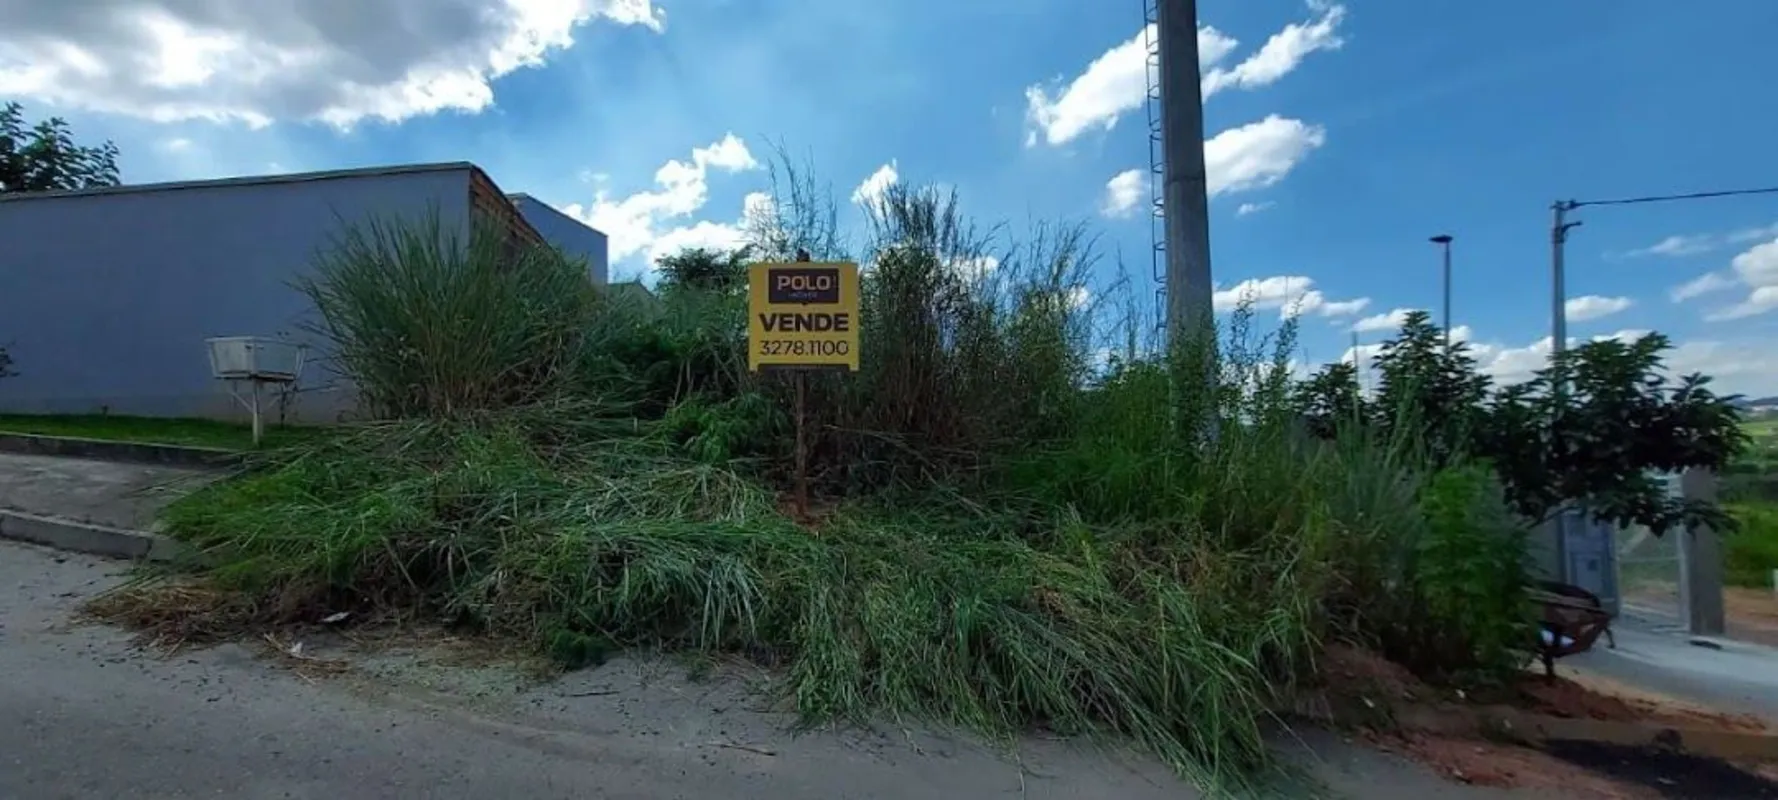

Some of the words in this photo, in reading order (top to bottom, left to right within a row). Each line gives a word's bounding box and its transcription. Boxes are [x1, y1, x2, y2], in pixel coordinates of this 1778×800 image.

[777, 275, 830, 290] POLO
[759, 313, 849, 332] VENDE
[759, 340, 849, 356] 3278.1100
